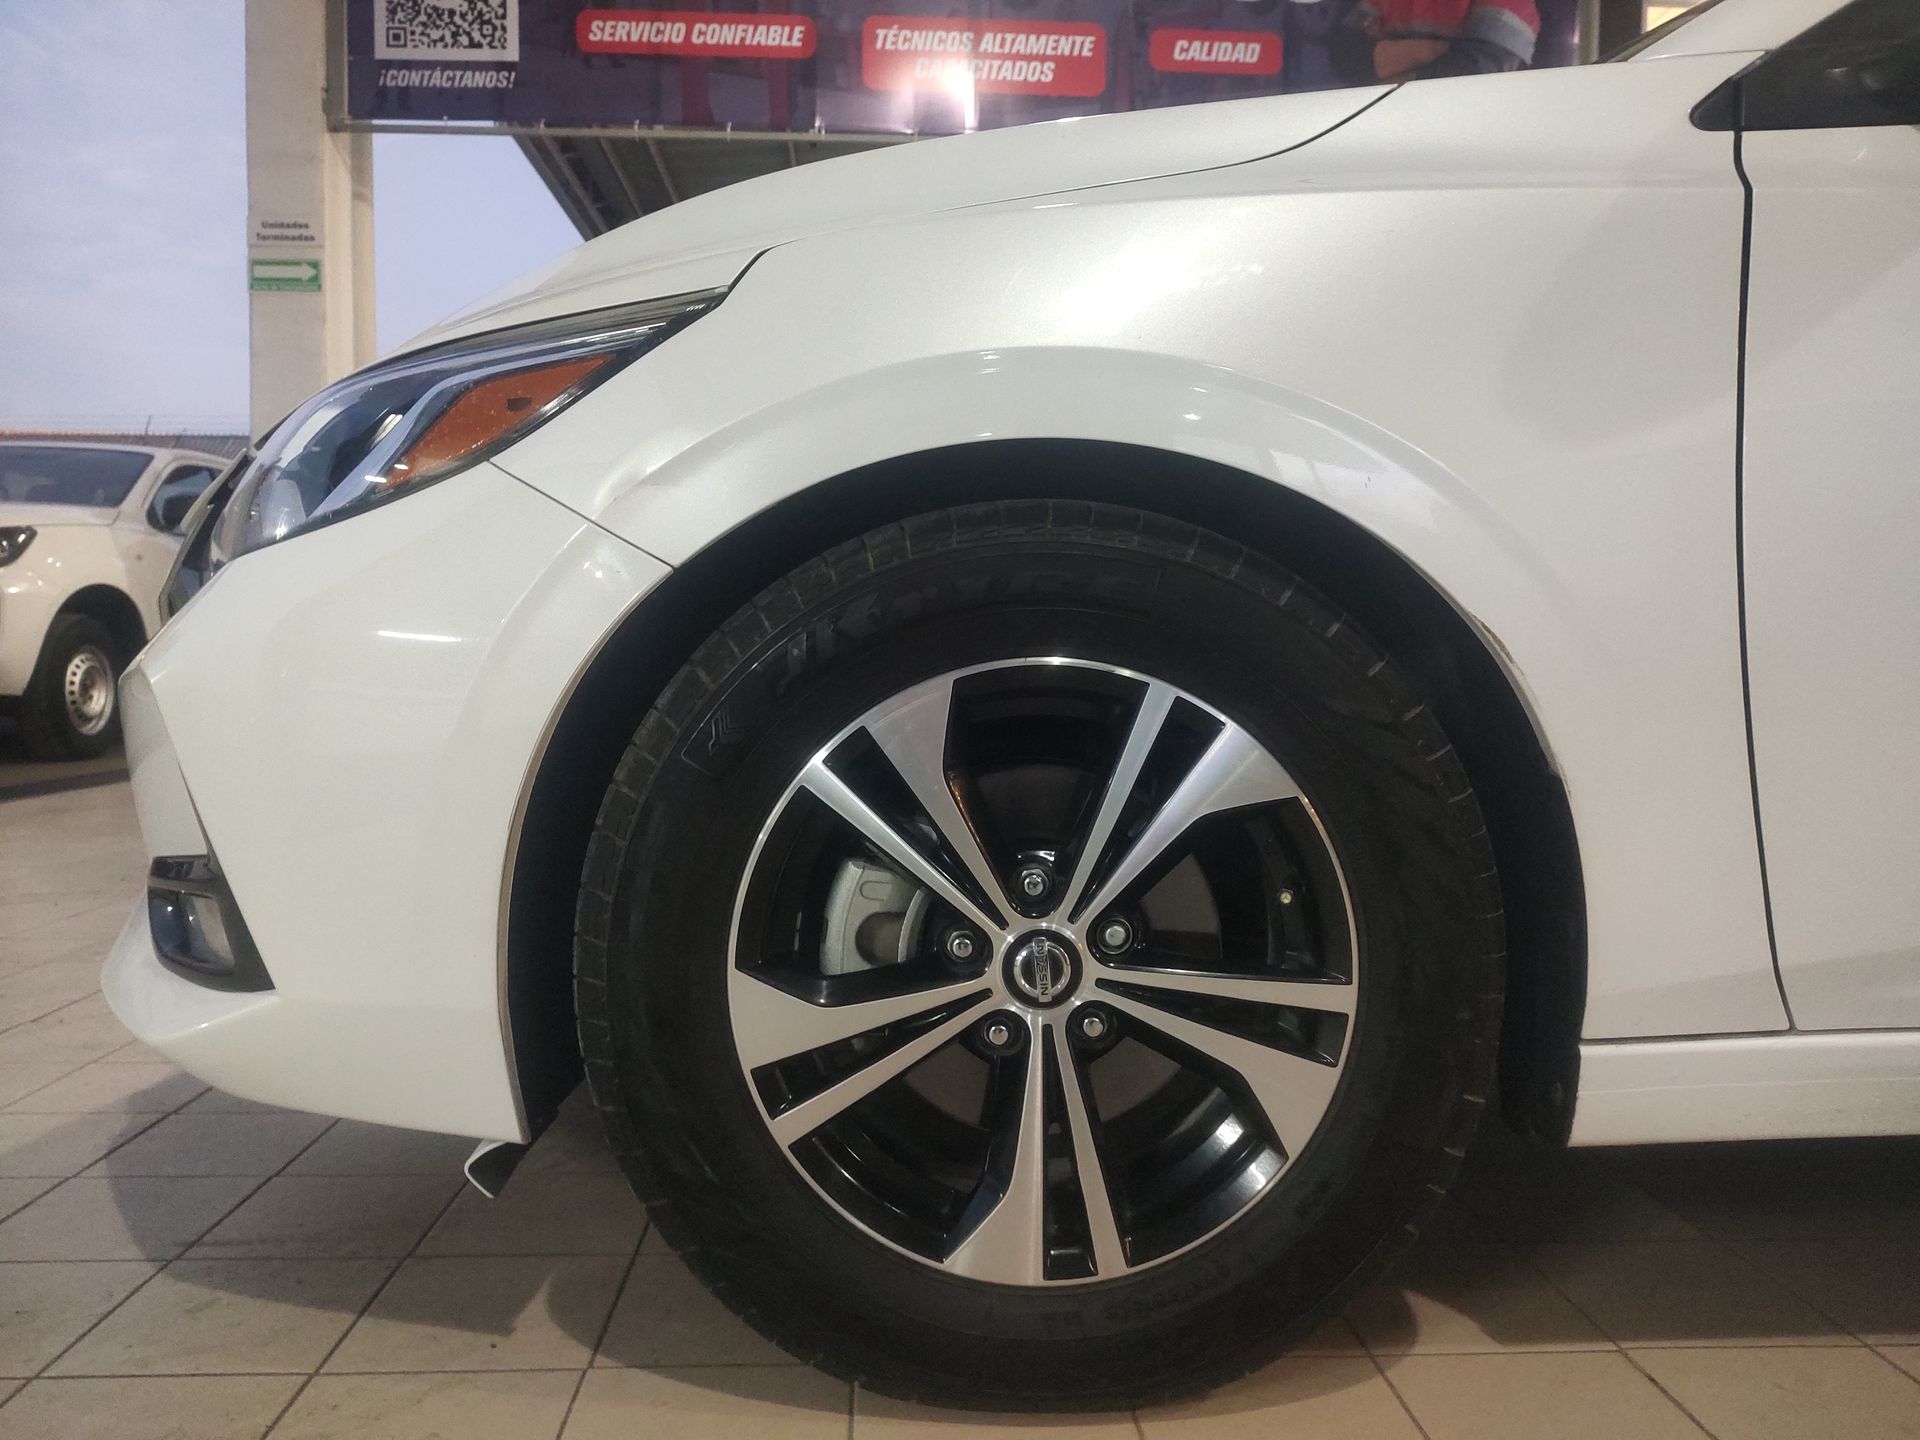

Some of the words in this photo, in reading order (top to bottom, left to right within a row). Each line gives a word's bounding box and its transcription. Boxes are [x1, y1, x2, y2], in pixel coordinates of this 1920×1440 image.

[589, 20, 686, 42] SERVICIO
[692, 22, 805, 47] CONFIABLE
[876, 25, 973, 50] TÉCNICOS
[979, 32, 1096, 57] ALTAMENTE
[1173, 40, 1261, 64] CALIDAD
[379, 67, 516, 88] ¡CONTÁCTANOS!
[1035, 943, 1050, 997] NISSAN
